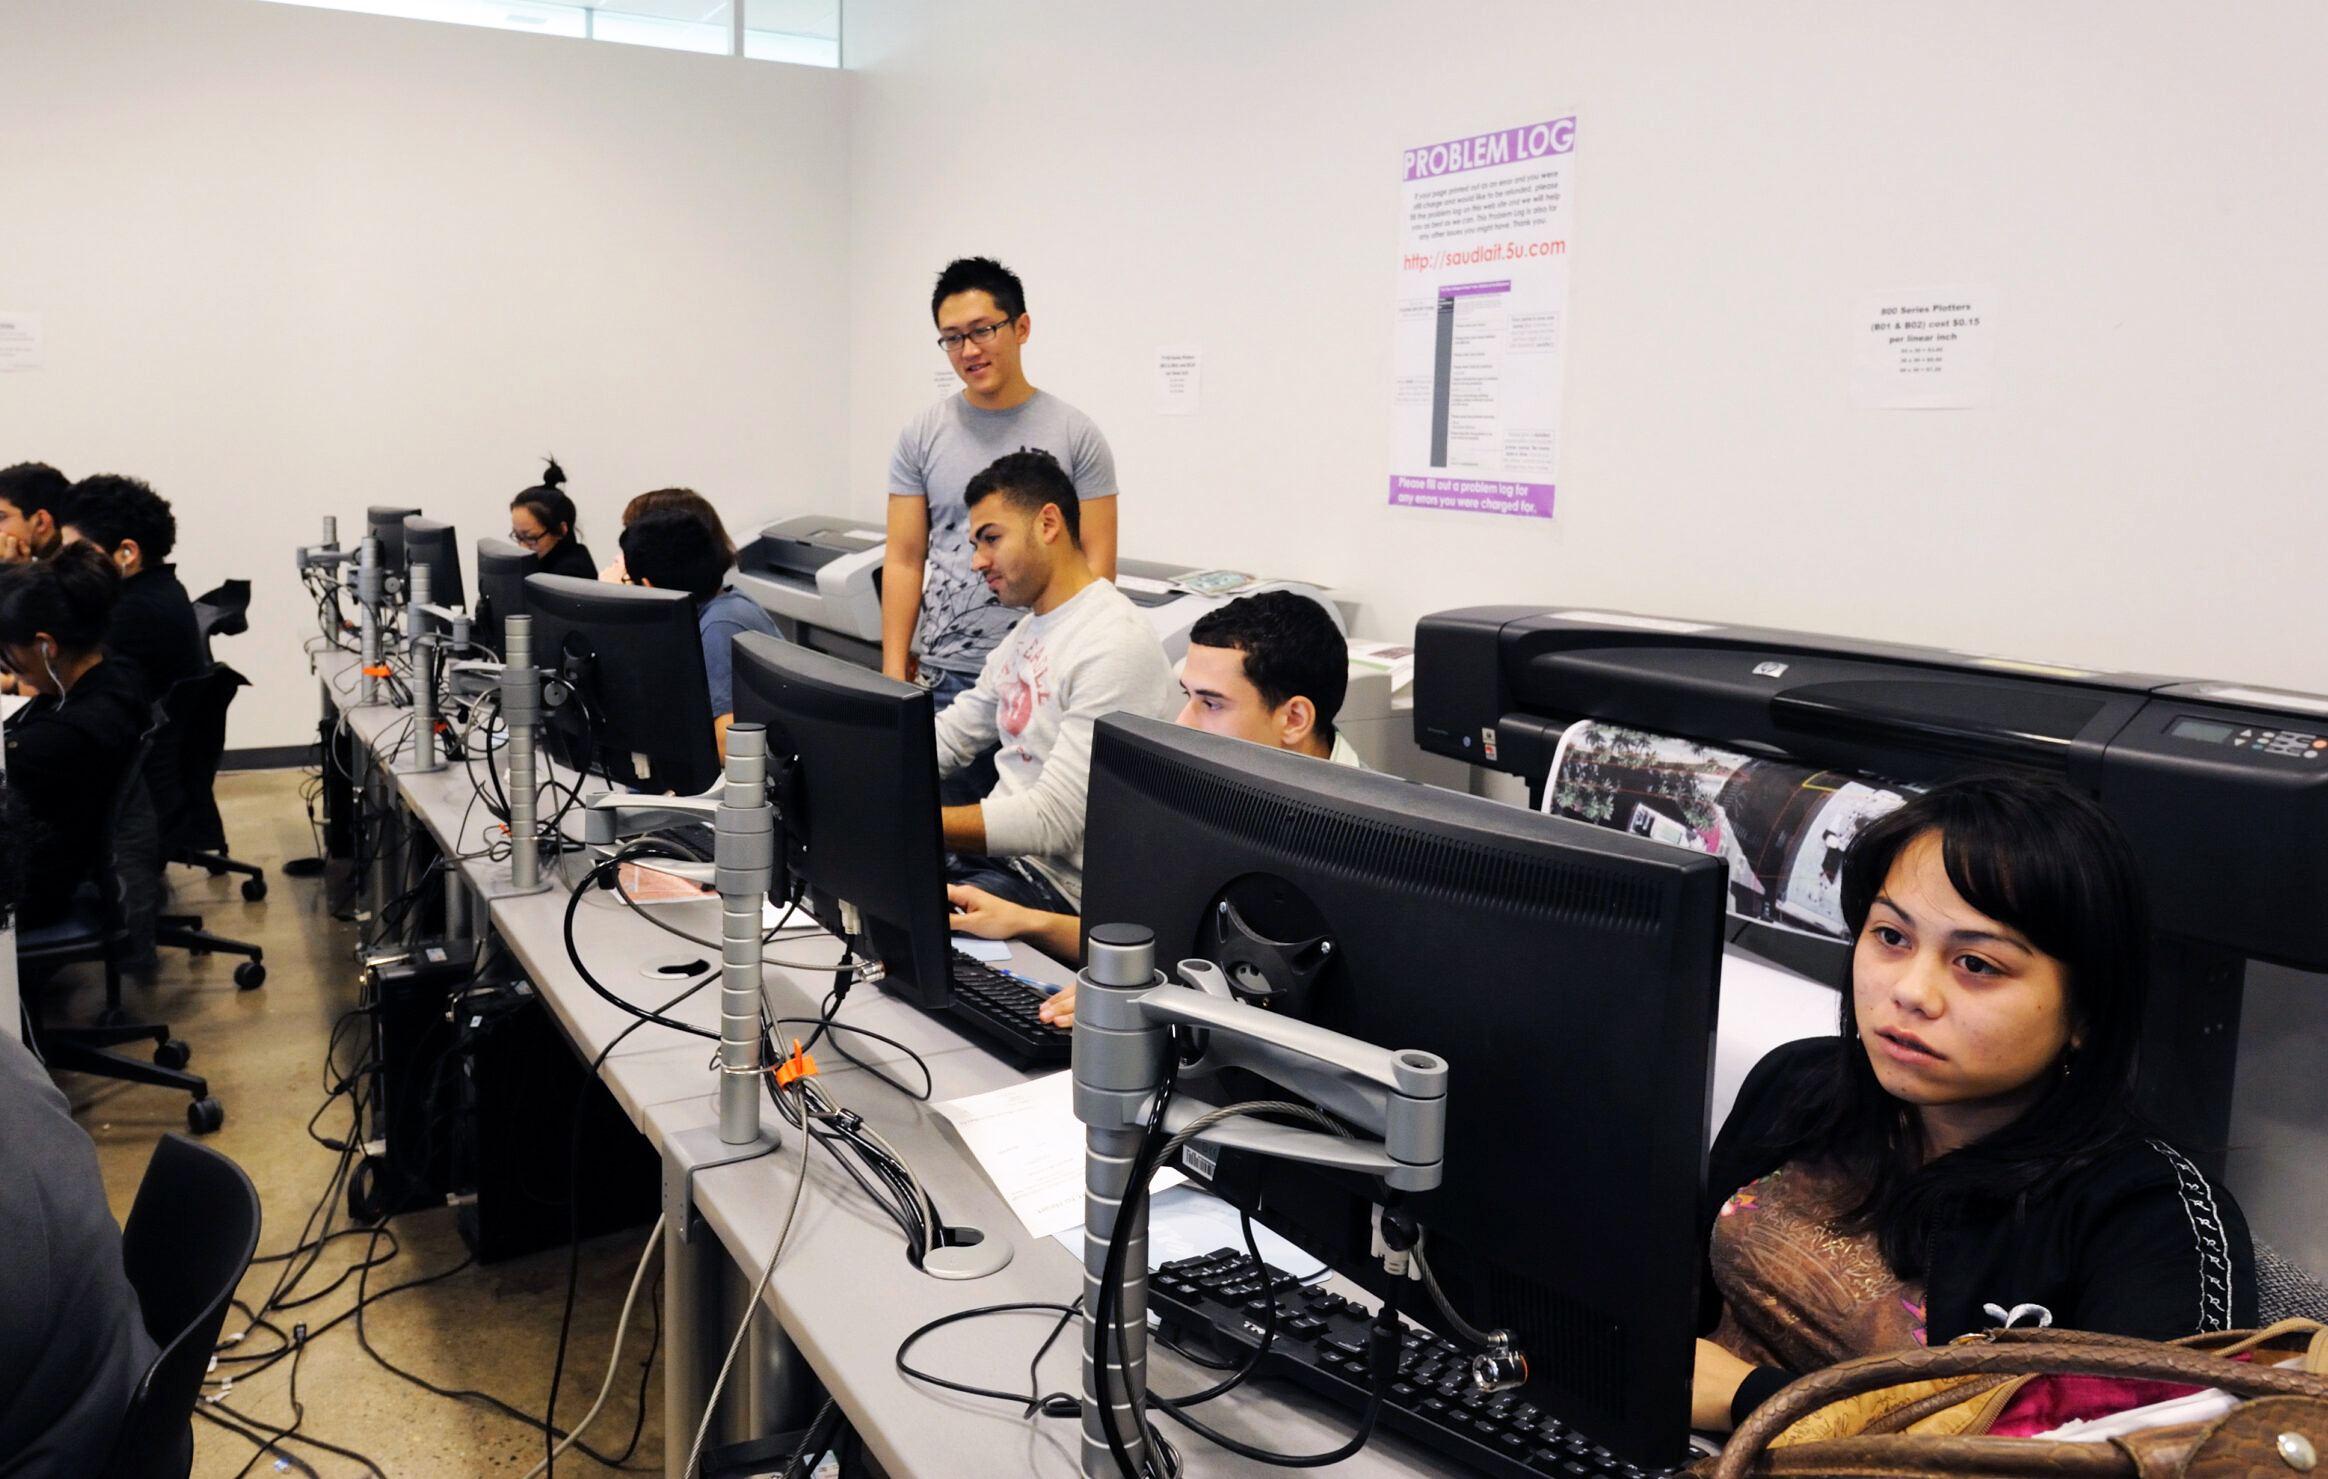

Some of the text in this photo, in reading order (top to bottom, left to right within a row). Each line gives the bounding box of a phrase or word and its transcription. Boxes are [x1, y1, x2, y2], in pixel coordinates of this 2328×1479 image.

[1404, 118, 1574, 179] PROBLEM LOG
[1900, 306, 1929, 314] Series
[1932, 304, 1971, 312] Plotters
[1928, 320, 1950, 328] cost
[1953, 318, 1980, 327] $0.15
[1889, 333, 1957, 344] per linear inch
[1398, 476, 1528, 497] Please fill out a problem log for
[1397, 493, 1537, 514] any errors you were charged for.
